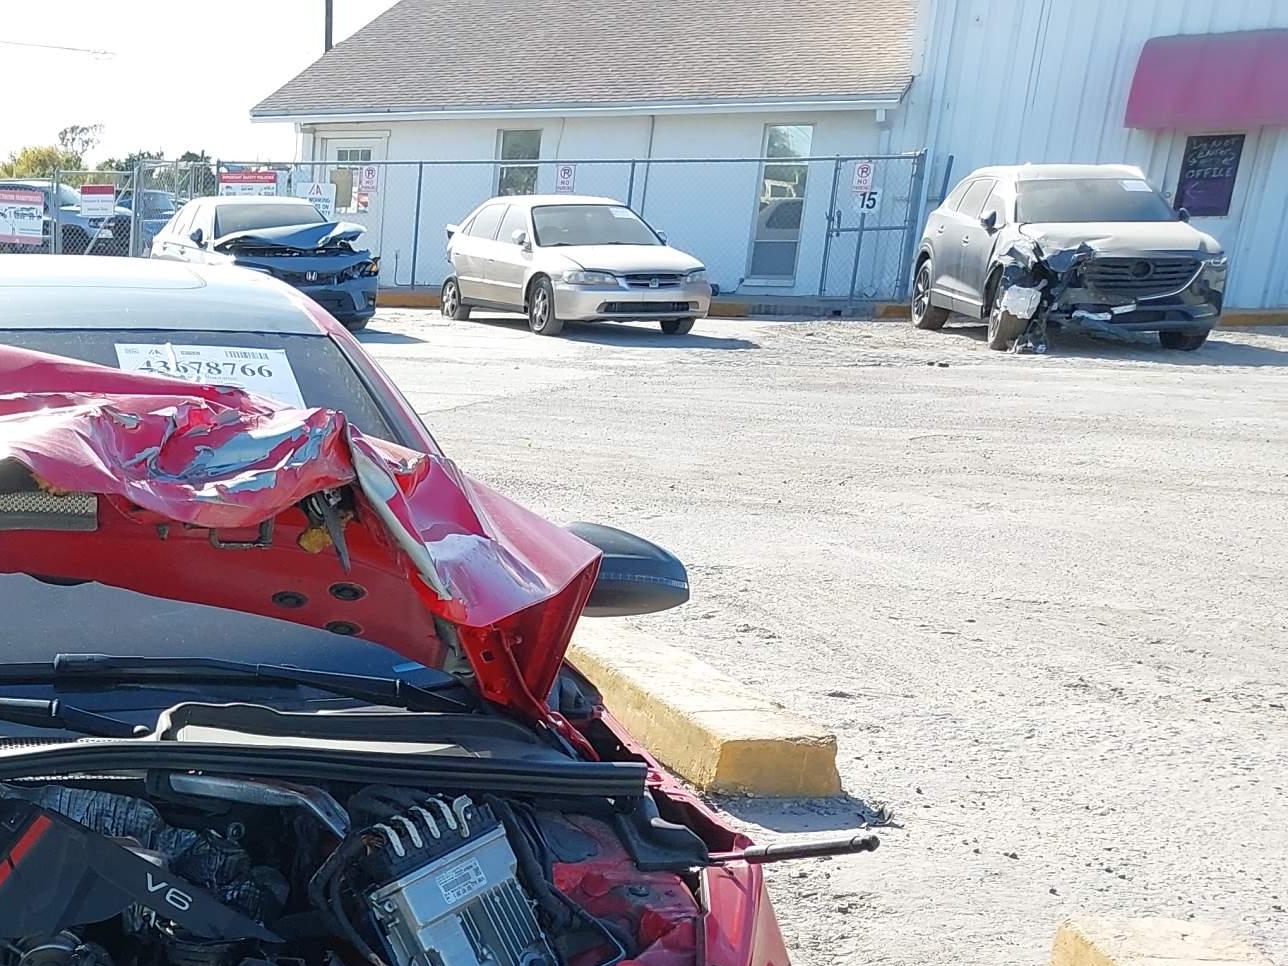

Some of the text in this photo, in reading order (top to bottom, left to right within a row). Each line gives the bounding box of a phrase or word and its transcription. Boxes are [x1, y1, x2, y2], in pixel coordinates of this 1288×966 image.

[1185, 167, 1234, 179] OFFICE
[860, 192, 877, 209] 15
[139, 360, 273, 378] 43678766
[146, 872, 193, 911] V6
